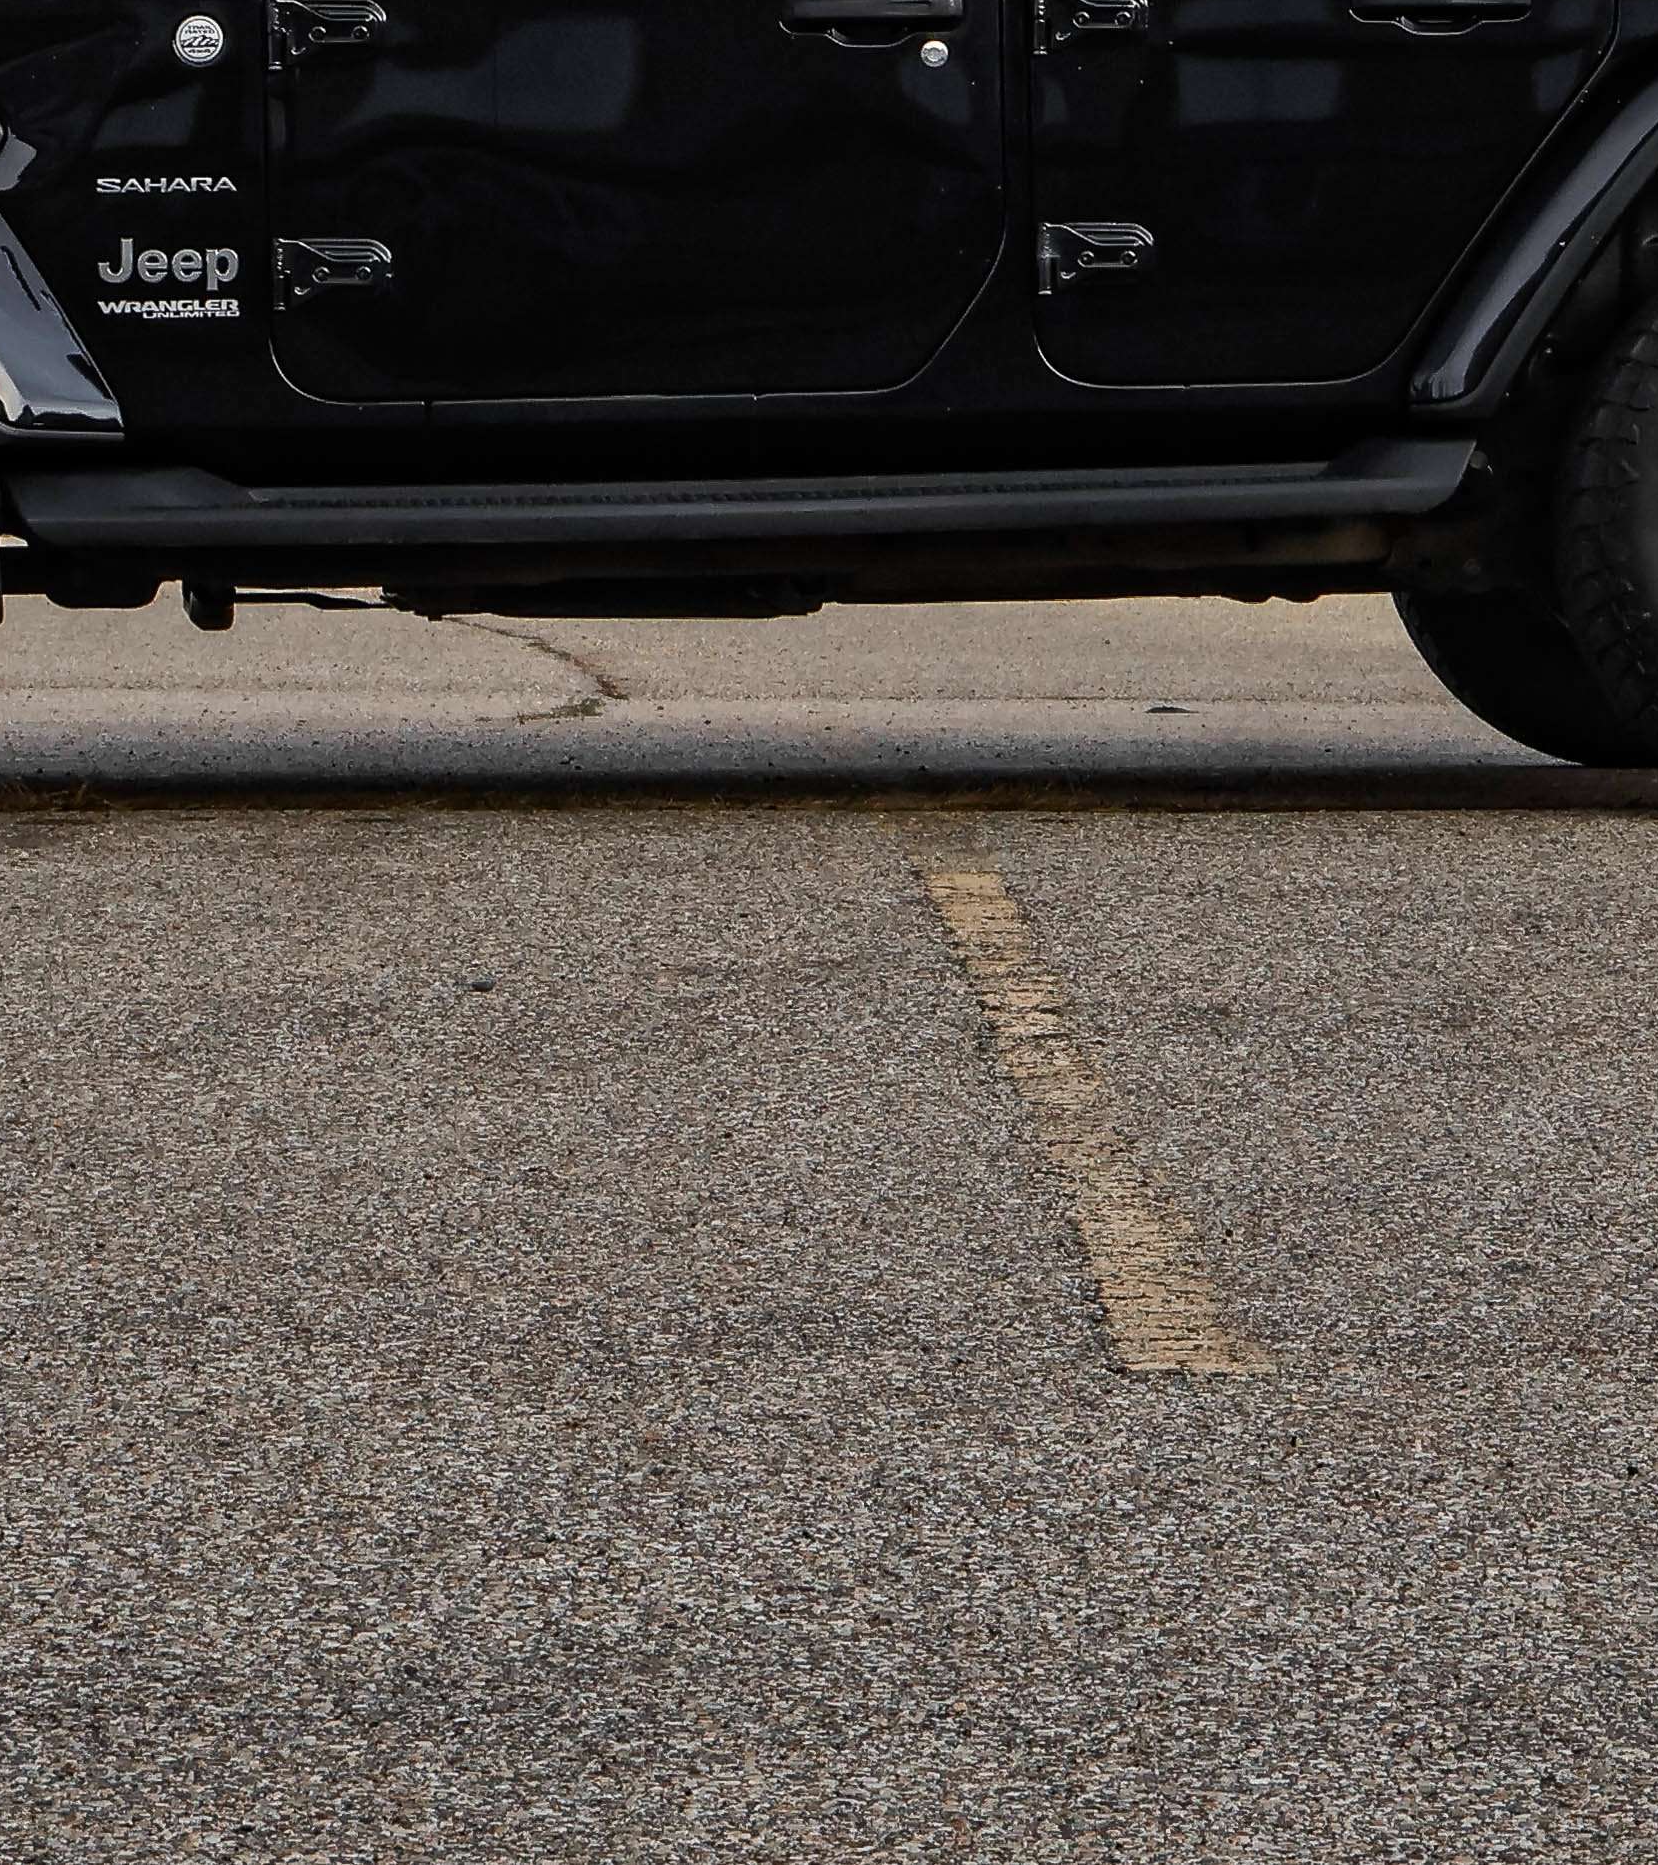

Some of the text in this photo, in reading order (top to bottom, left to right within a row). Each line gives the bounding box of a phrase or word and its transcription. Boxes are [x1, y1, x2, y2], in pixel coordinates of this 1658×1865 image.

[96, 177, 237, 193] SAHARA
[97, 238, 239, 291] Jeep
[97, 299, 240, 314] WRANGLER
[142, 310, 240, 319] UNLIMITED
